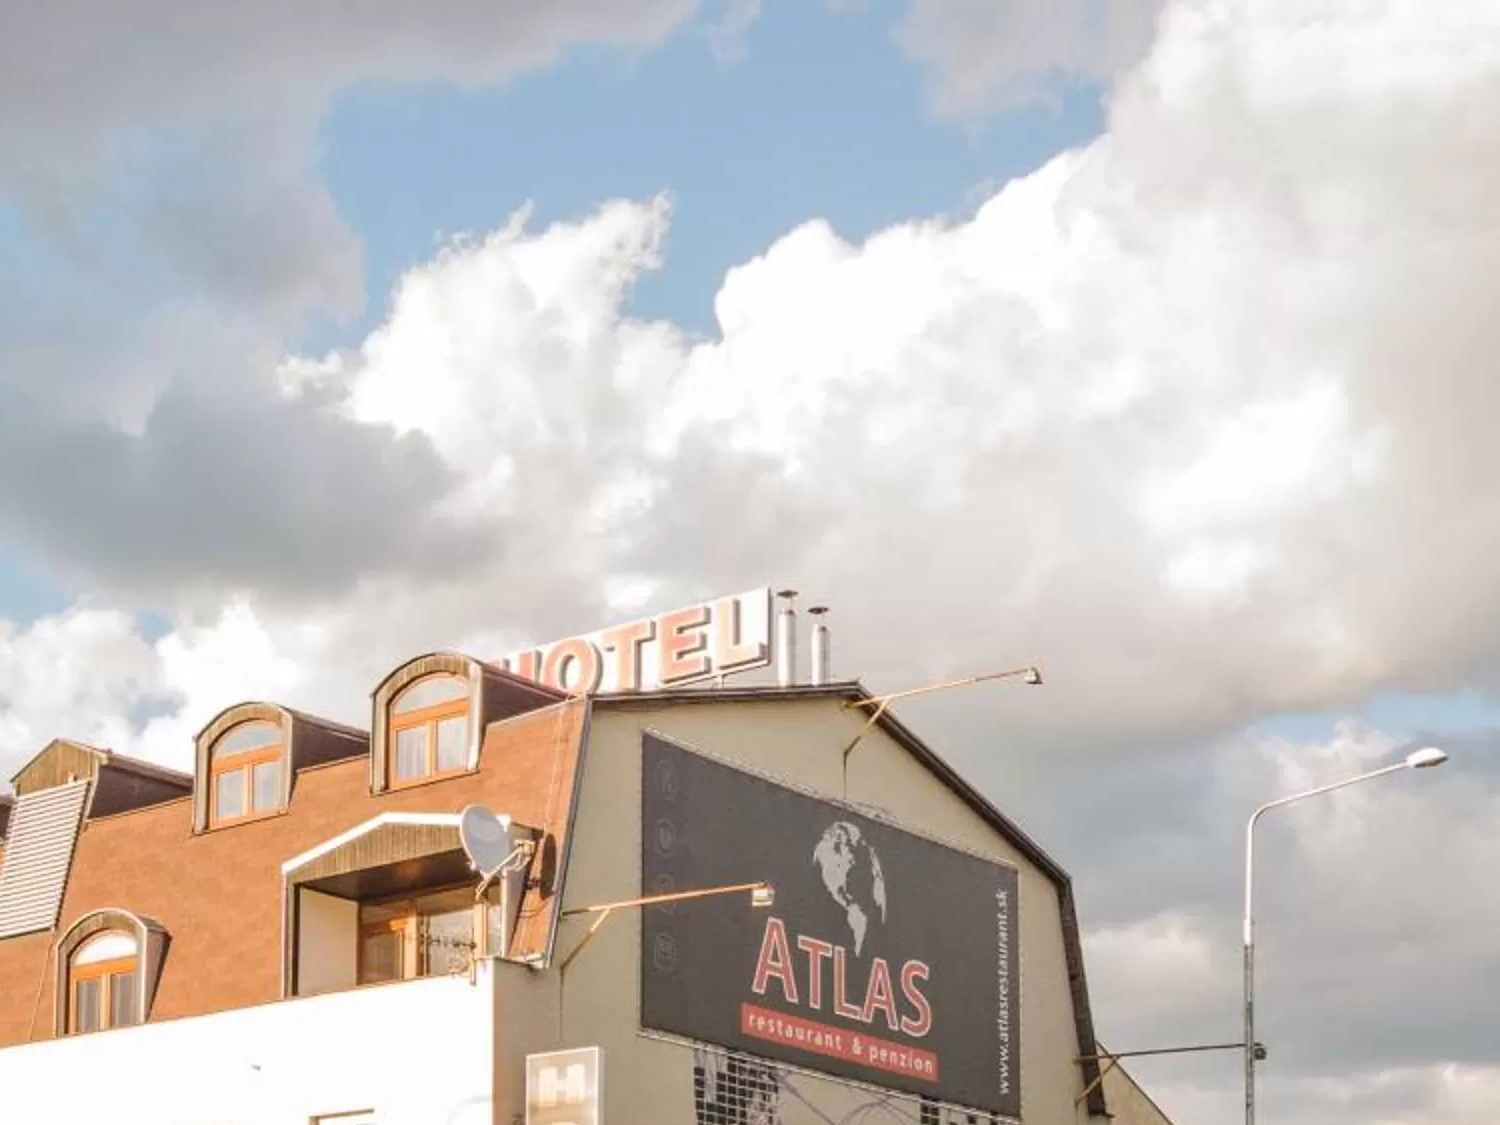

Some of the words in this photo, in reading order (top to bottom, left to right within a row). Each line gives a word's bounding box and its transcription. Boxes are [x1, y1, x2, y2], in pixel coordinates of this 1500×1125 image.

[752, 915, 932, 1037] ATLAS
[748, 1012, 842, 1051] restaurant
[851, 1037, 862, 1057] &
[868, 1045, 933, 1074] penzion
